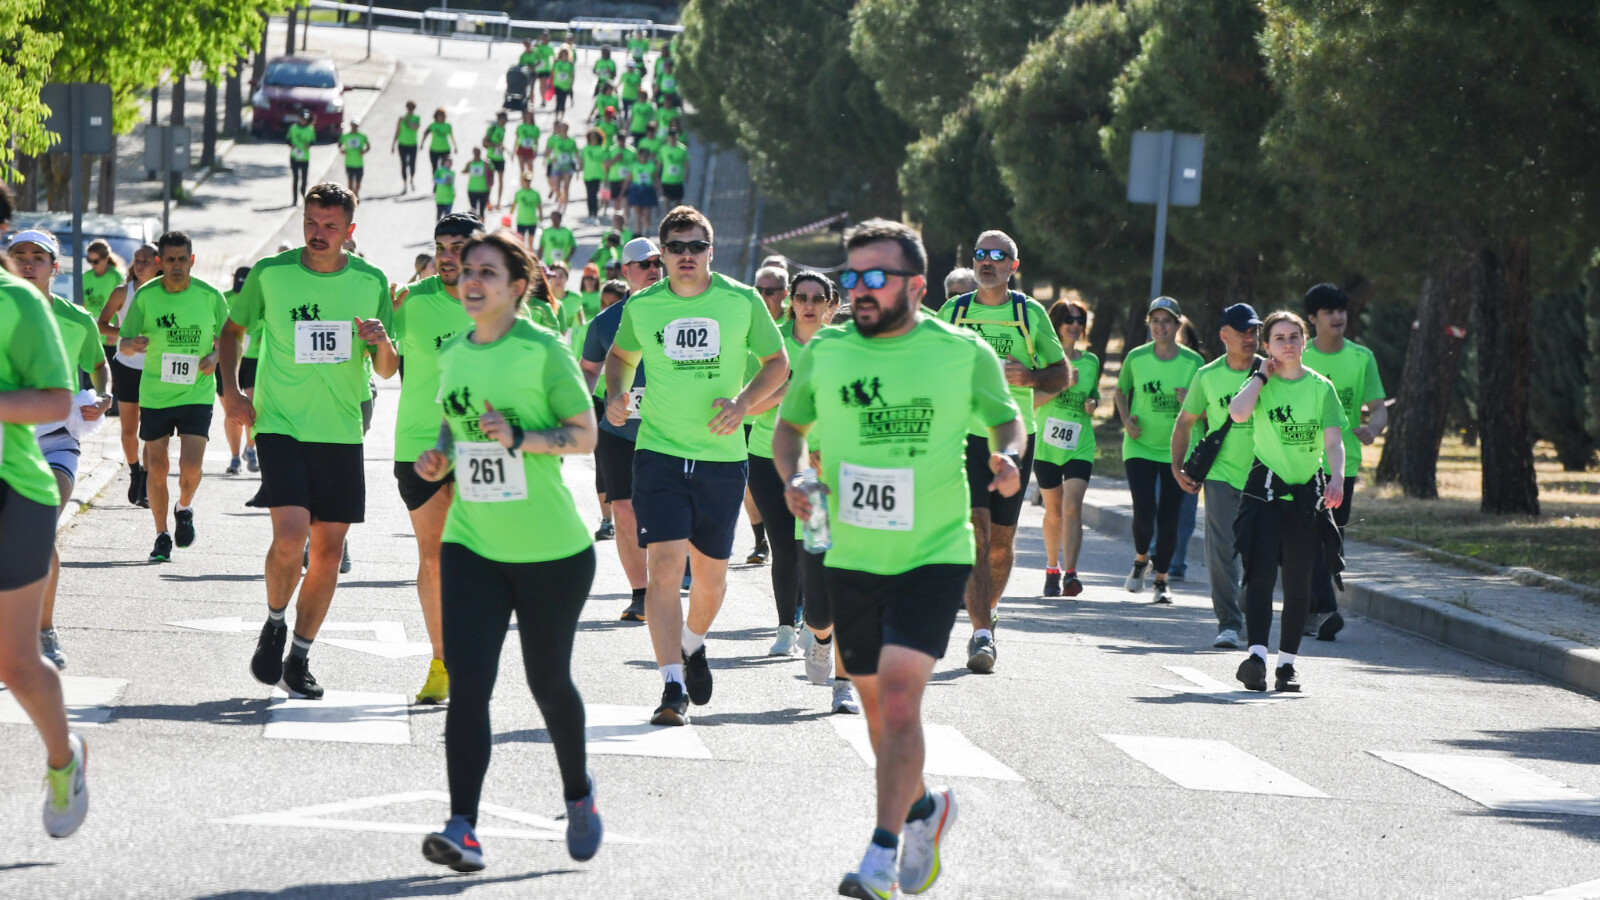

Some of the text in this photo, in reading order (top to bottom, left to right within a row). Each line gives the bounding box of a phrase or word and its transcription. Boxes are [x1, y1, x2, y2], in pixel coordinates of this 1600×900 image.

[310, 331, 336, 351] 115
[676, 328, 707, 348] 402
[171, 361, 189, 376] 119
[870, 409, 933, 422] CARRERA
[859, 421, 930, 436] INCLUSIVA
[1051, 426, 1073, 442] 248
[469, 458, 505, 484] 261
[853, 482, 895, 512] 246
